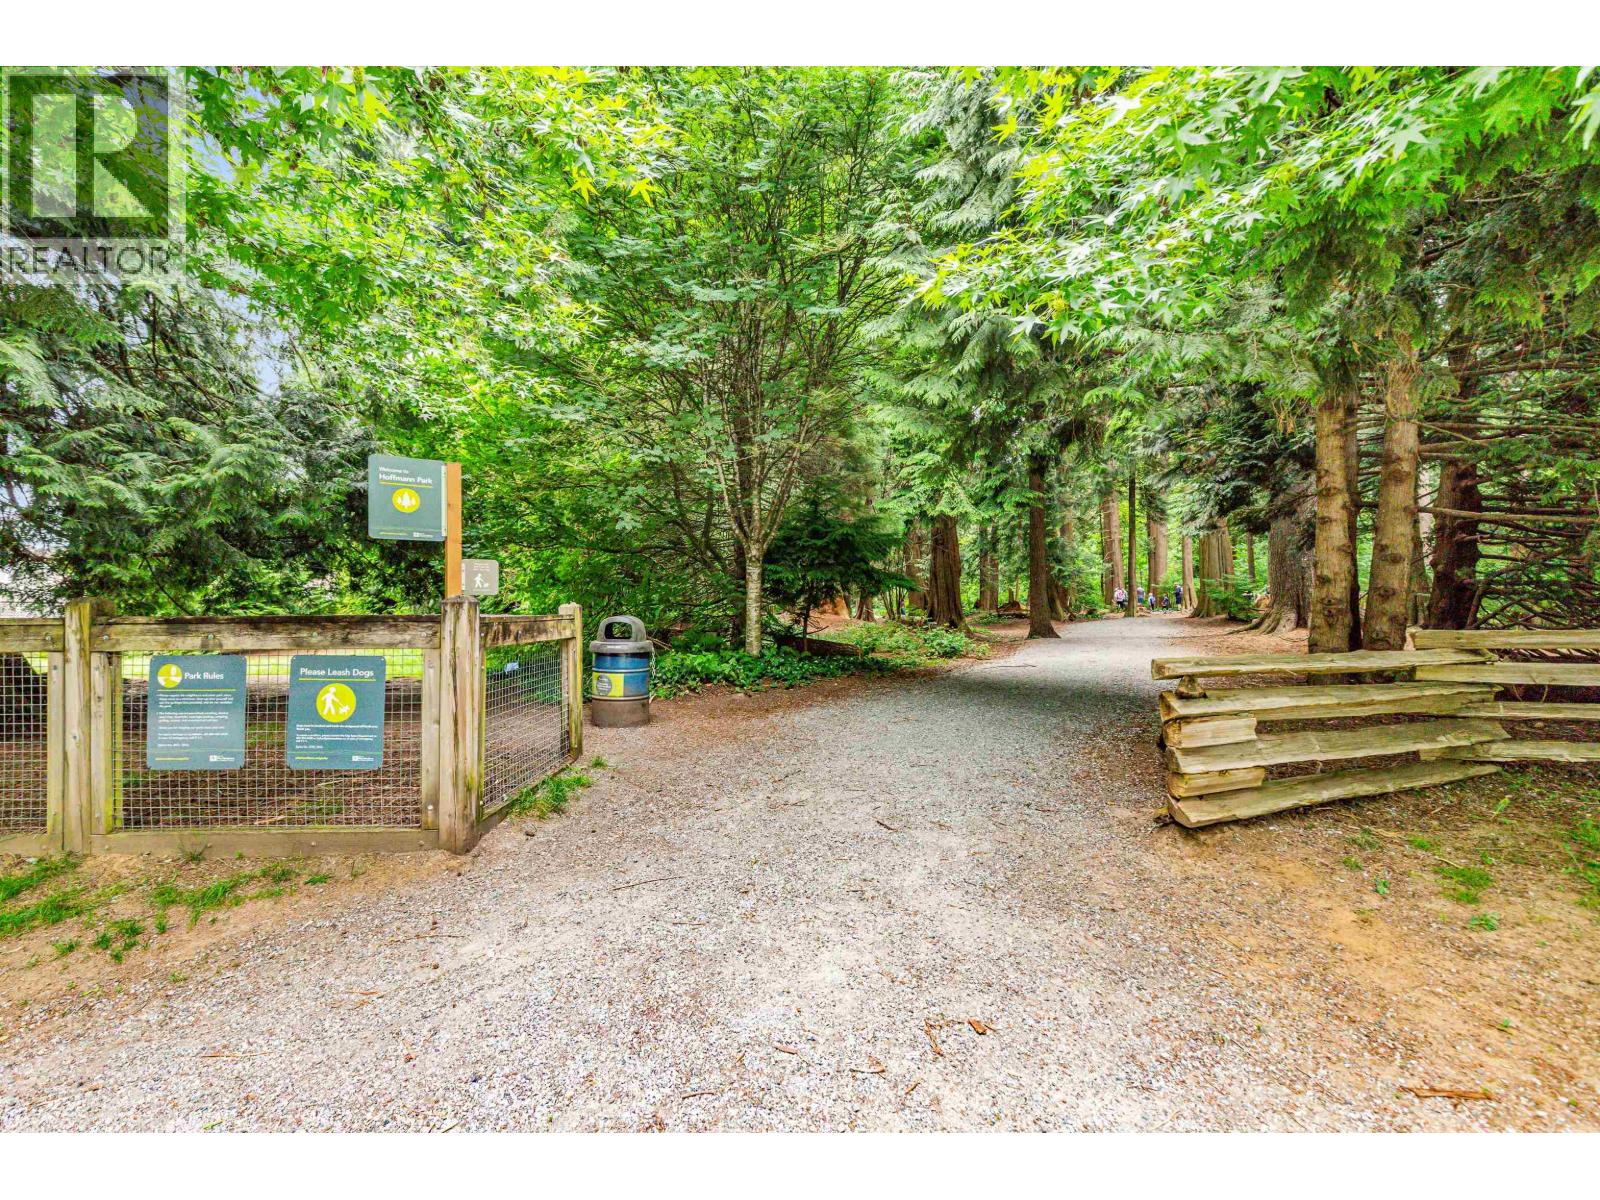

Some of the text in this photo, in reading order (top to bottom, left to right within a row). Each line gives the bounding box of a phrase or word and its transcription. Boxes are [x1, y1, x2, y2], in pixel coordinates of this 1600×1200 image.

[379, 473, 433, 484] Hoffmann Park
[184, 672, 224, 680] Park Rules
[300, 667, 375, 678] Please Leash Dogs
